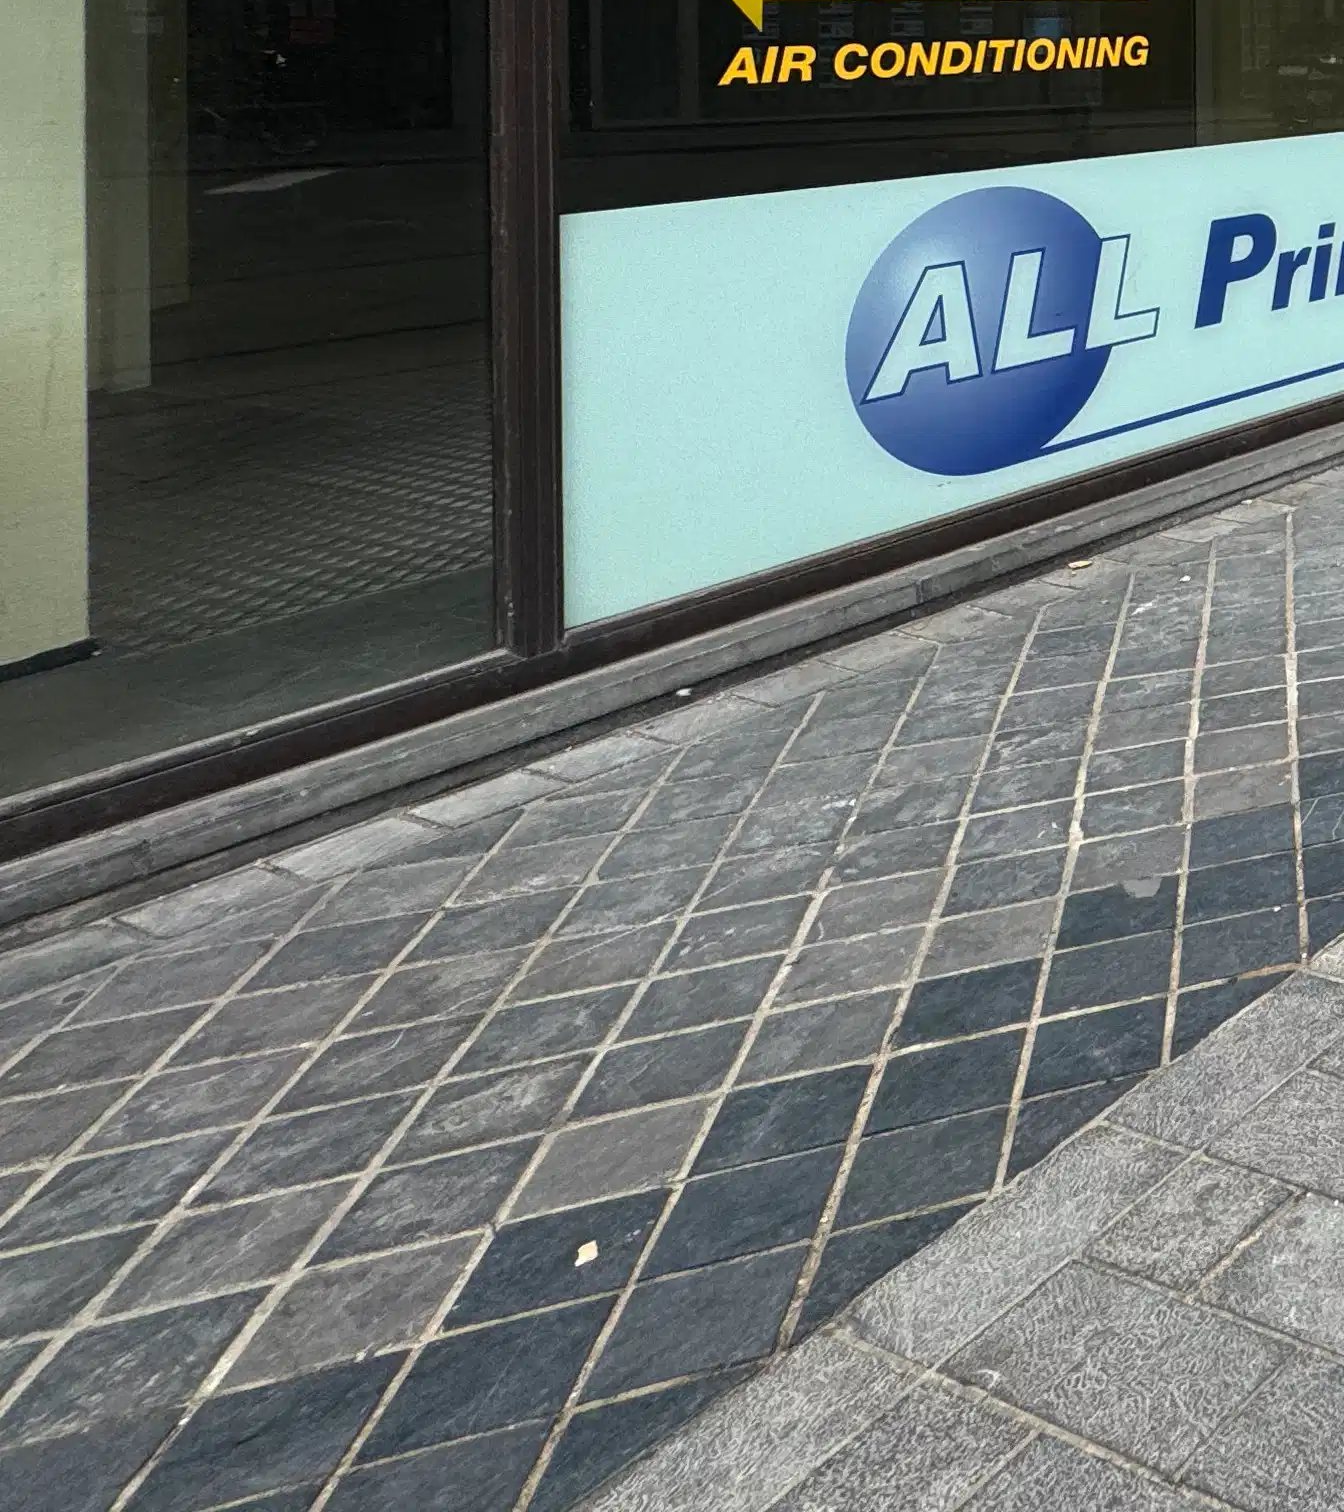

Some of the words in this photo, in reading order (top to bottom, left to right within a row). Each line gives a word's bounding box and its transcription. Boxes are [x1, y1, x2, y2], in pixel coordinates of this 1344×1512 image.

[718, 45, 816, 86] AIR
[833, 35, 1149, 80] CONDITIONING
[862, 235, 1159, 404] ALL
